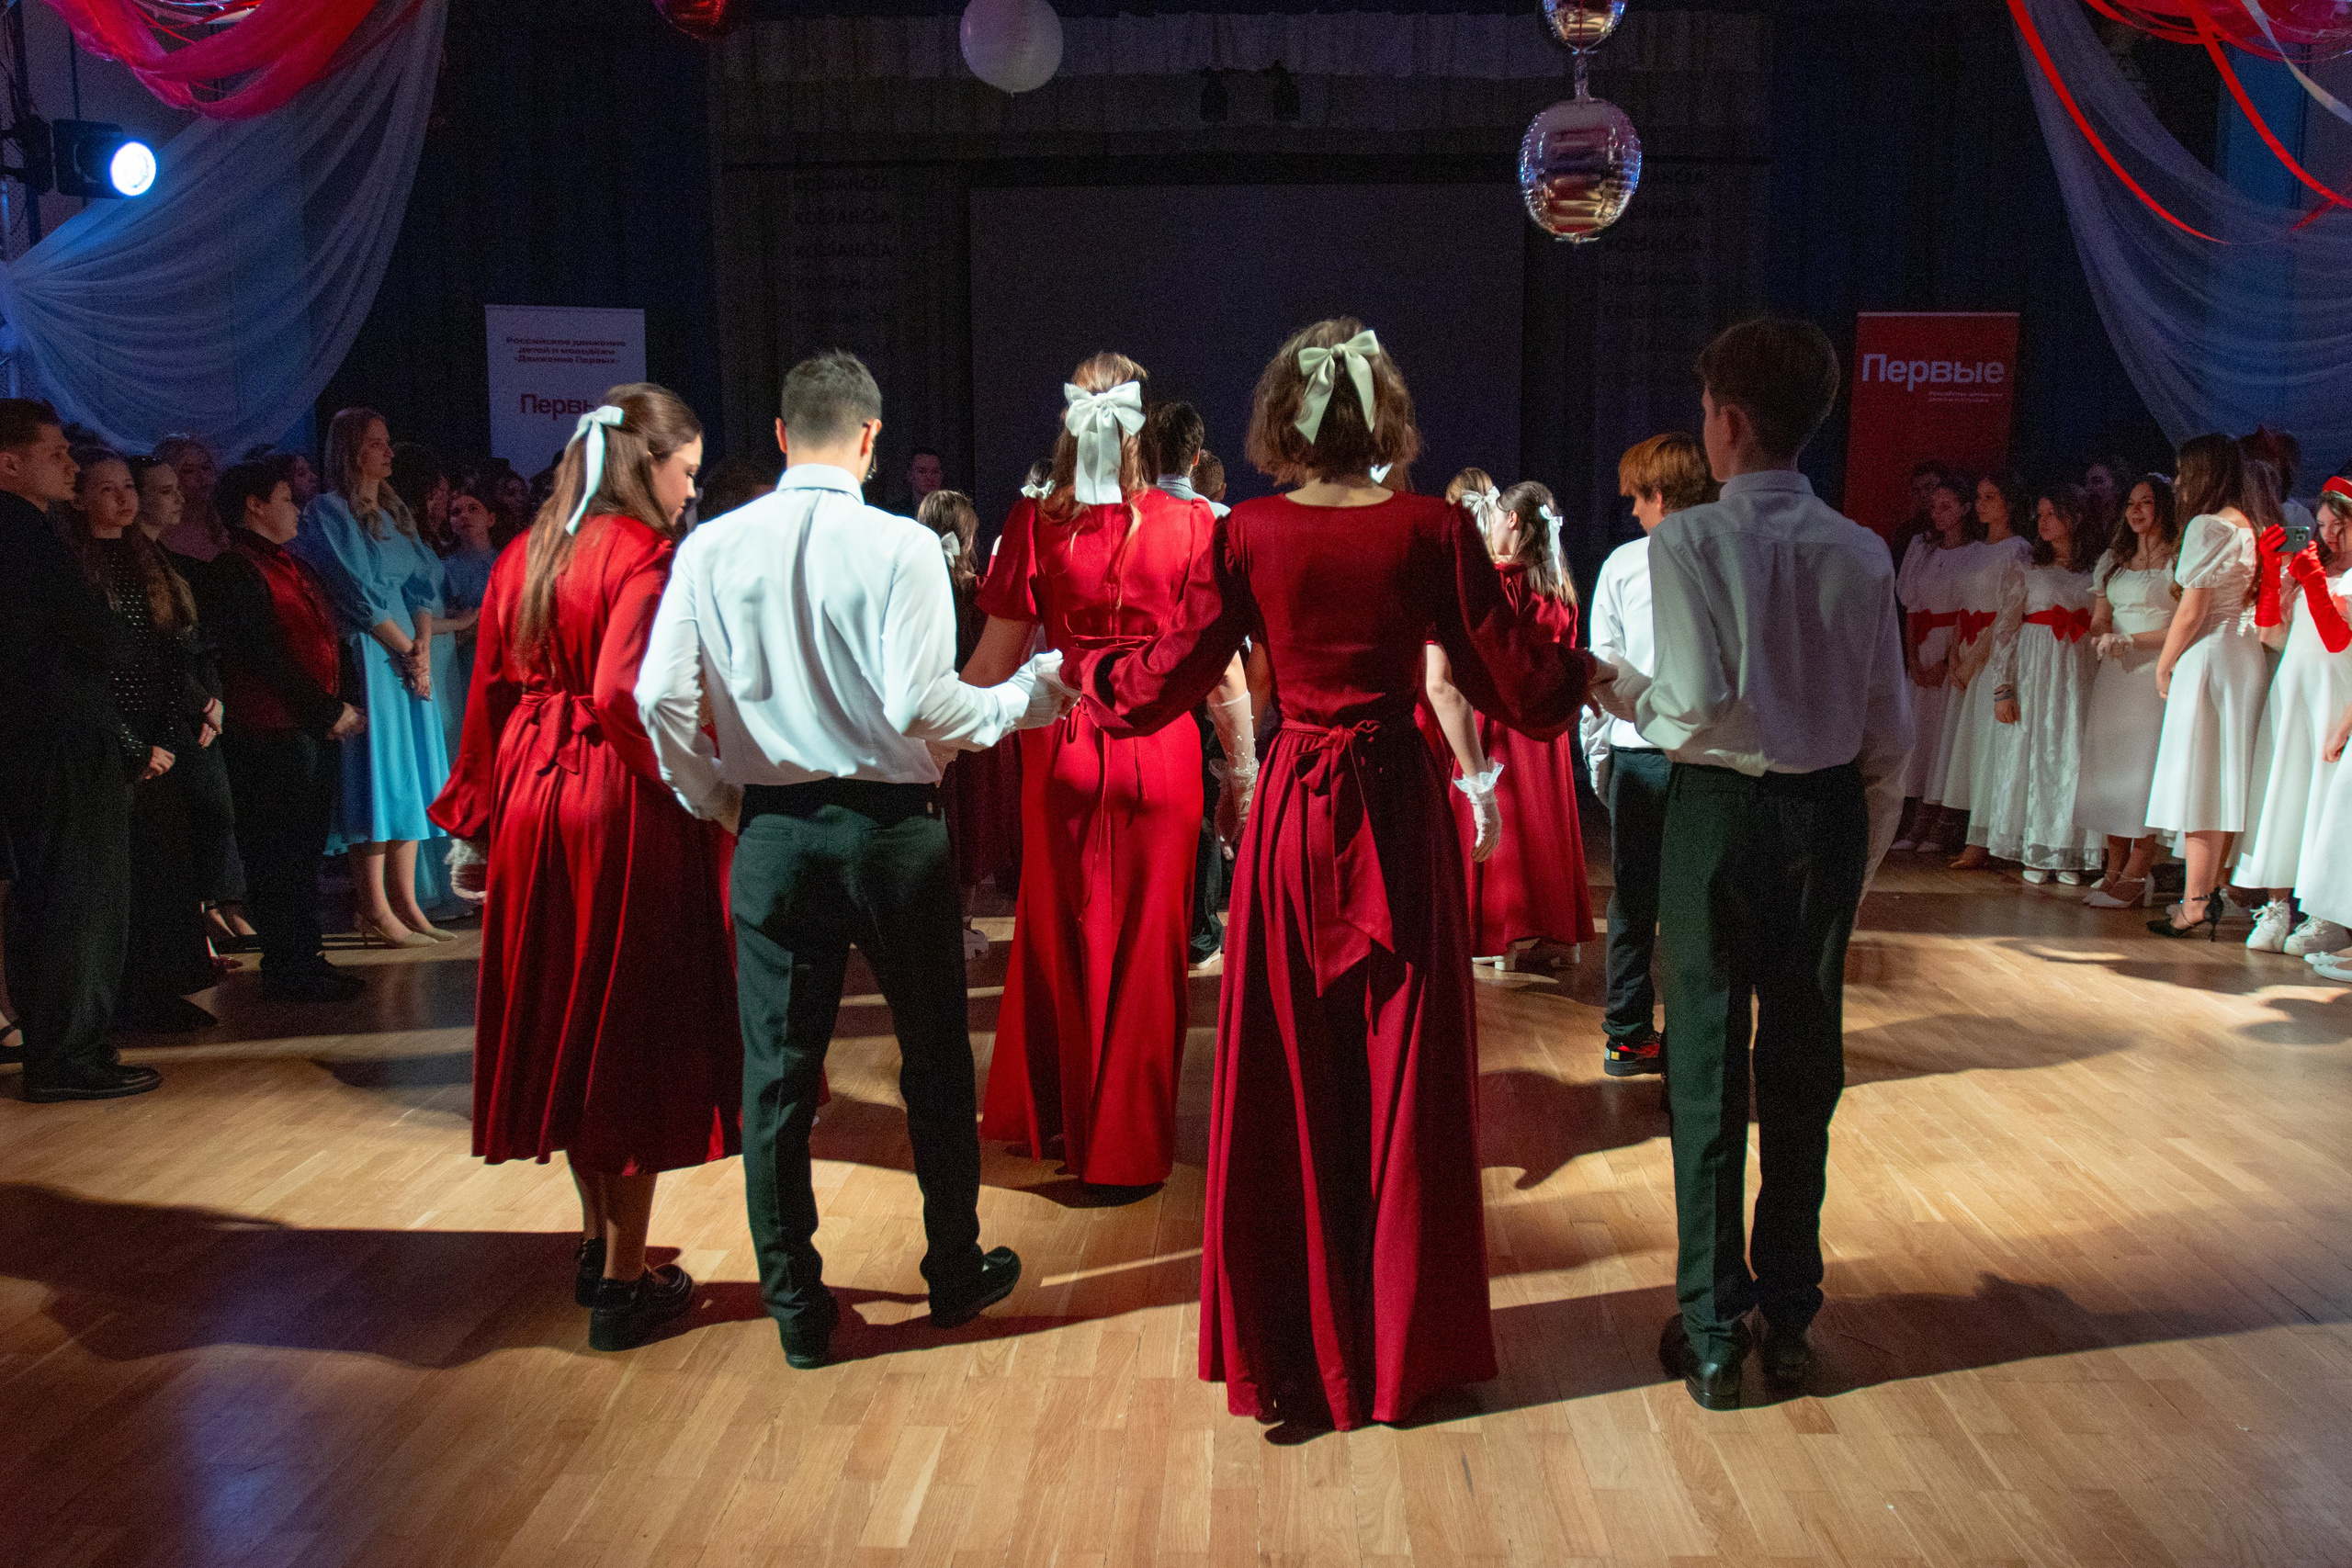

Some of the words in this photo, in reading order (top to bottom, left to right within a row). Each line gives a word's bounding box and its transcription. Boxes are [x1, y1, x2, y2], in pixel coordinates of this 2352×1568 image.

[506, 336, 571, 345] Российское
[572, 339, 627, 347] движение
[517, 346, 549, 355] детей
[1862, 354, 2005, 392] Первые
